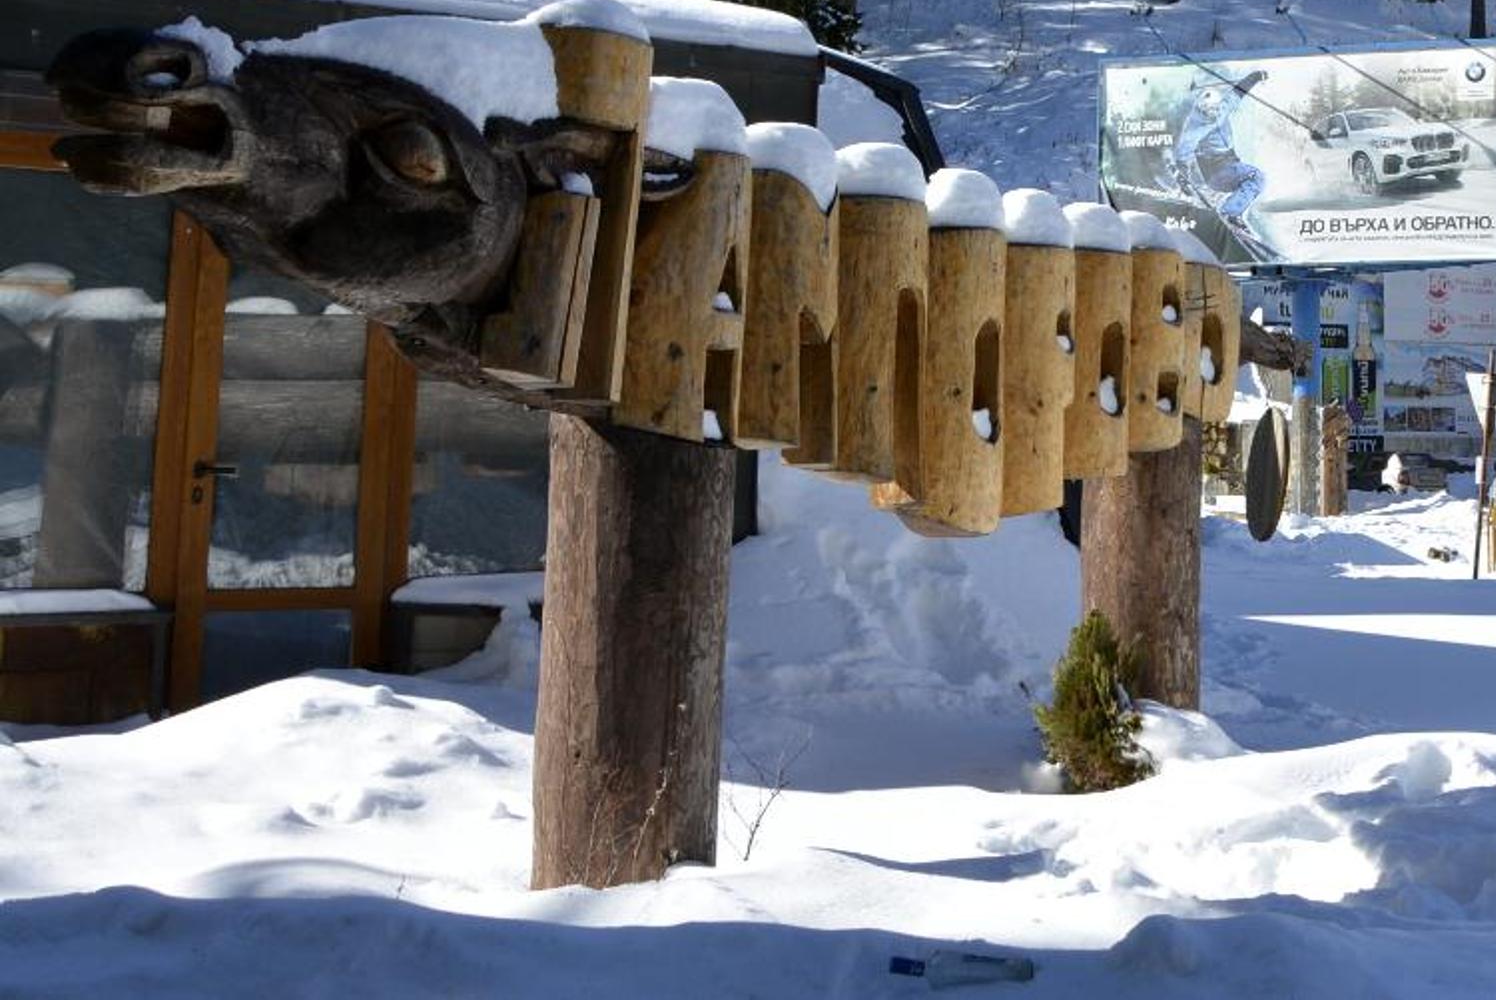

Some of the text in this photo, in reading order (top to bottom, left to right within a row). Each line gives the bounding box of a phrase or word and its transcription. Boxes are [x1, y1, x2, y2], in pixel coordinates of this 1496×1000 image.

[1300, 215, 1495, 235] ДО ВЪРХА И ОБРАТНО.
